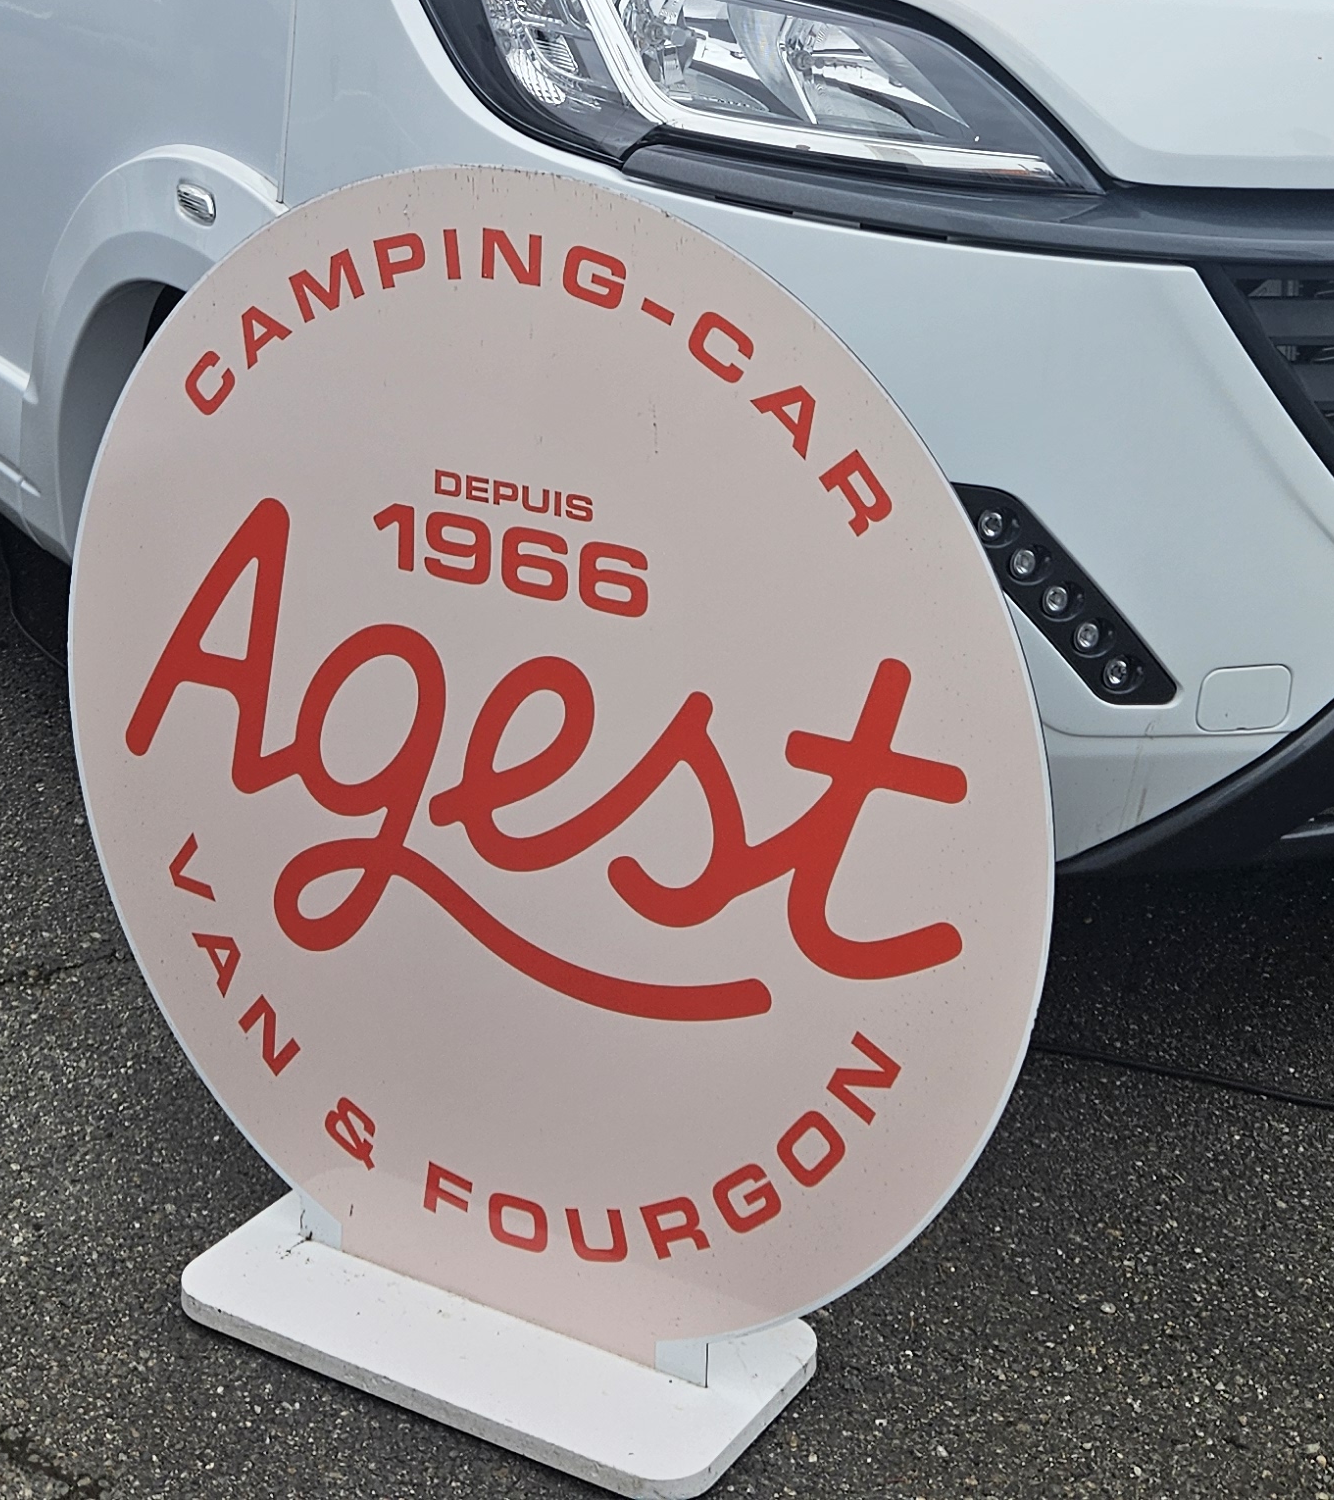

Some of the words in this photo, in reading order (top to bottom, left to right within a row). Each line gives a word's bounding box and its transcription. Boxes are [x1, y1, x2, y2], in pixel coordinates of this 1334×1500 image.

[184, 228, 894, 538] CAMPING-CAR
[433, 469, 595, 523] DEPUIS
[372, 503, 651, 618] 1966
[124, 497, 967, 1022] Agest
[168, 833, 302, 1076] VAN
[324, 1097, 377, 1171] &
[422, 1031, 903, 1263] FOURGON
